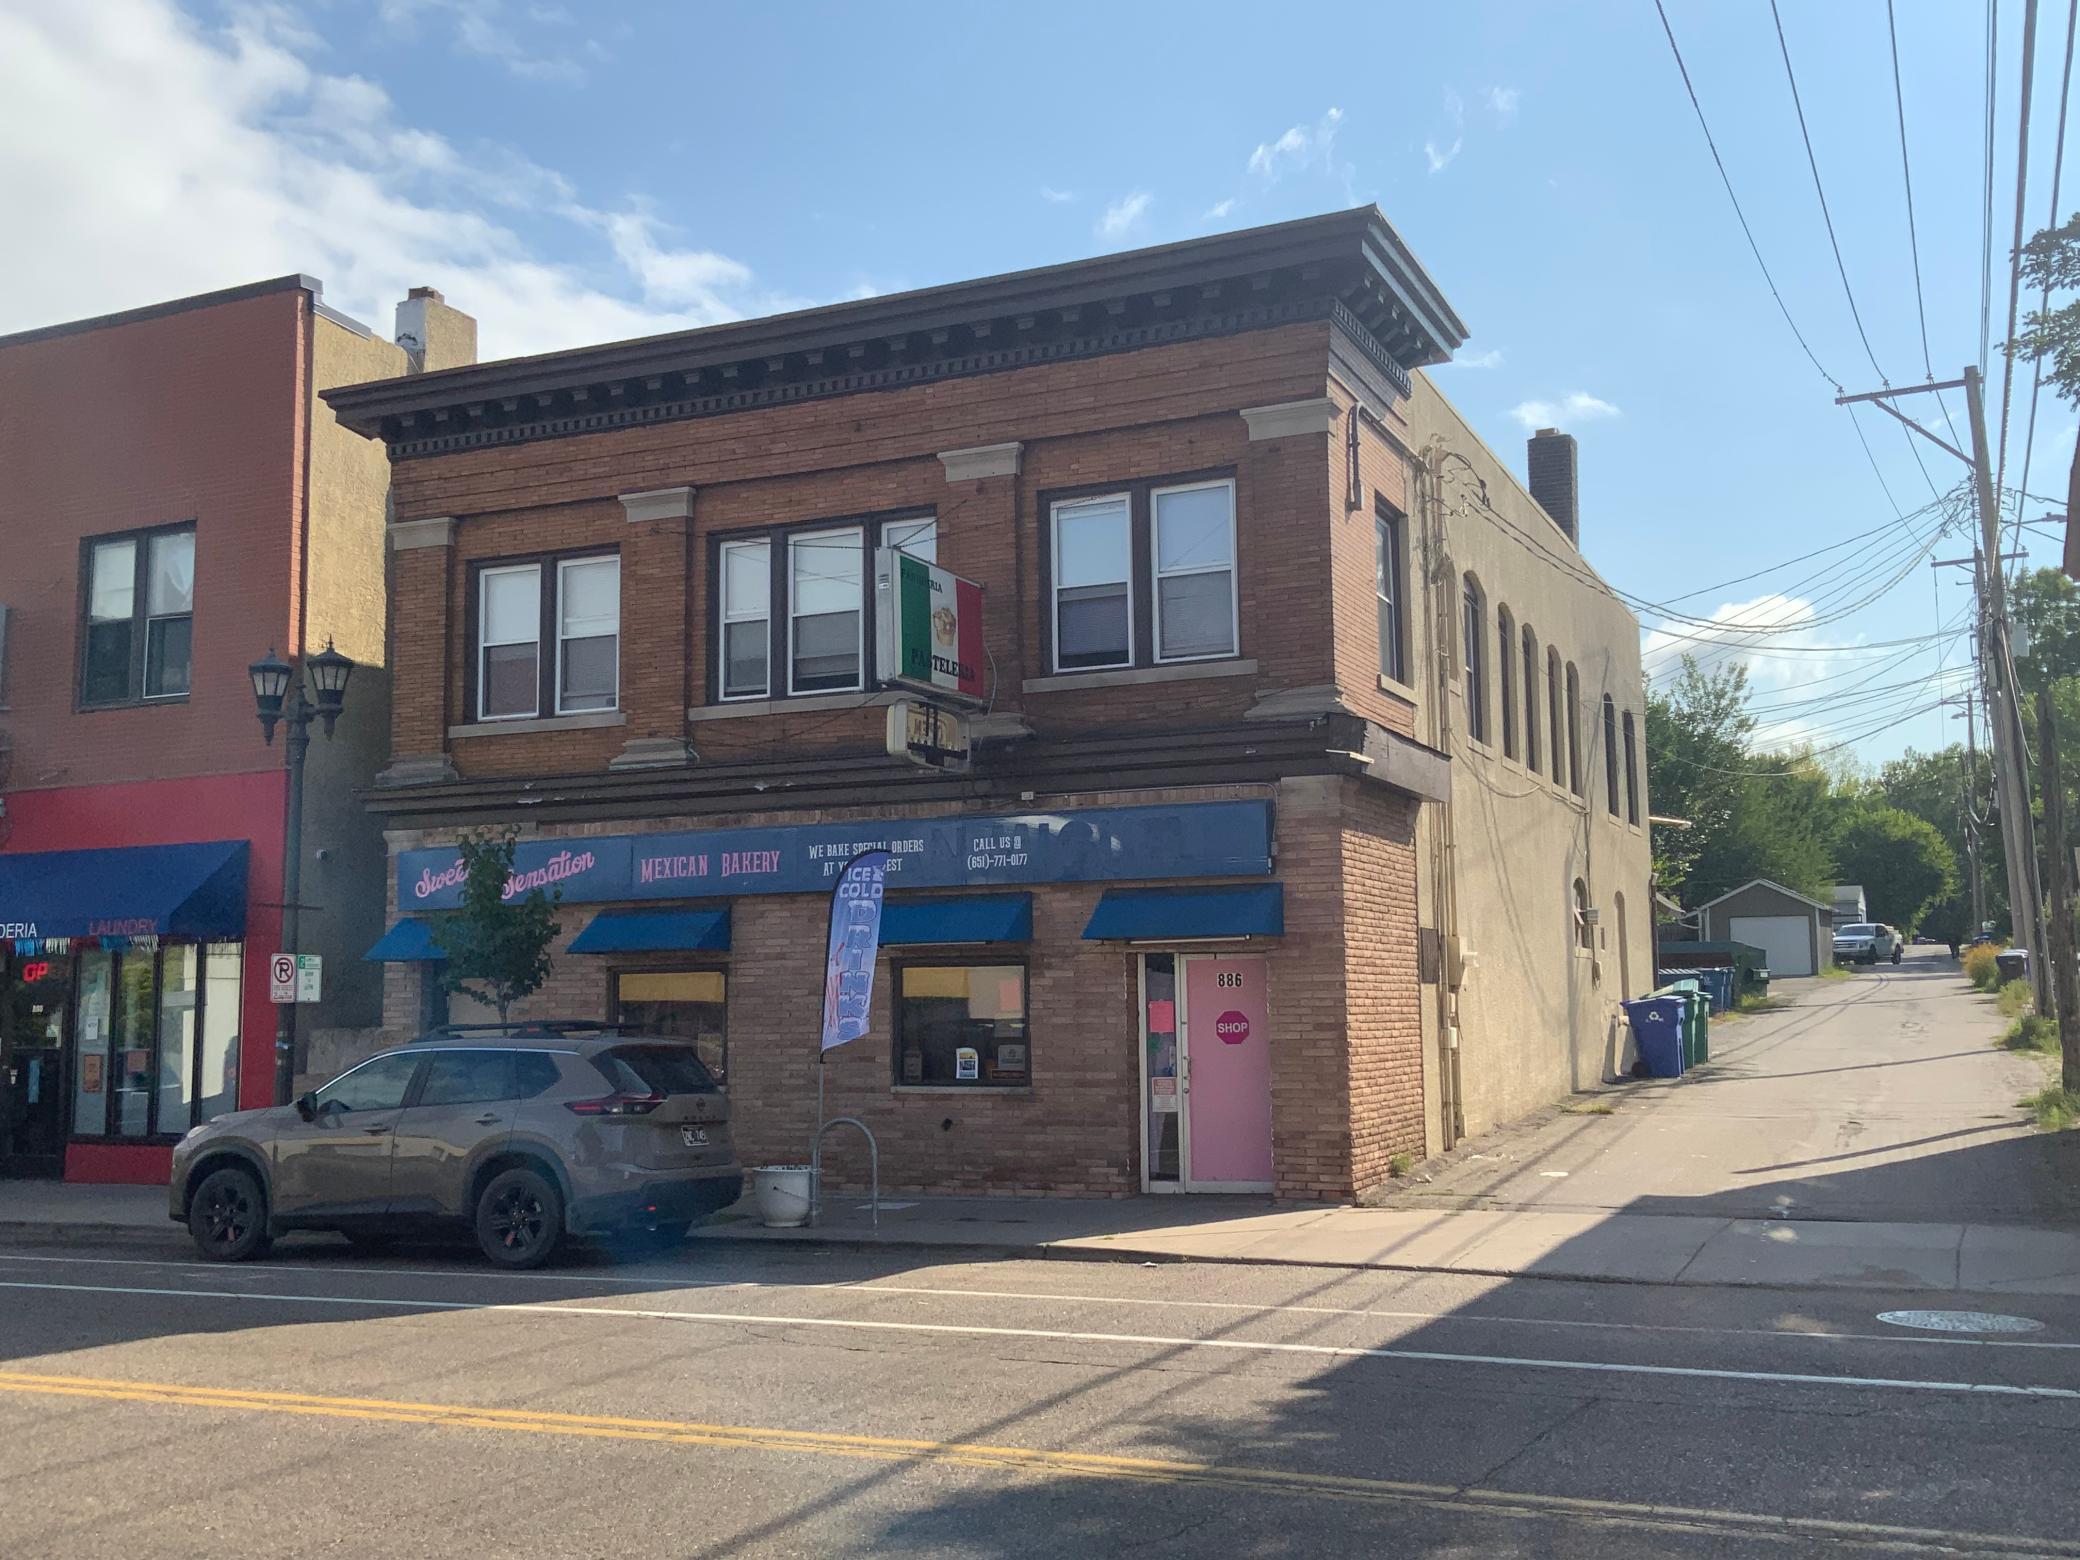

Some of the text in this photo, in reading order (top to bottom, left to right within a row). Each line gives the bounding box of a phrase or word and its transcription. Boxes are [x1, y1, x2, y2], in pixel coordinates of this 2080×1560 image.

[809, 845, 824, 859] WE
[827, 843, 850, 857] BAKE
[891, 839, 924, 853] ORDERS
[973, 837, 996, 852] CALL
[999, 836, 1011, 849] US
[640, 850, 780, 883] MEXICAN BAKERY
[823, 861, 835, 877] AT
[847, 867, 871, 882] ICE
[501, 850, 595, 900] Sensation
[840, 883, 884, 899] COLD
[88, 918, 159, 936] LAUNDRY
[837, 900, 878, 1041] DRINKS
[1218, 973, 1242, 988] 886
[1217, 1022, 1248, 1034] SHOP
